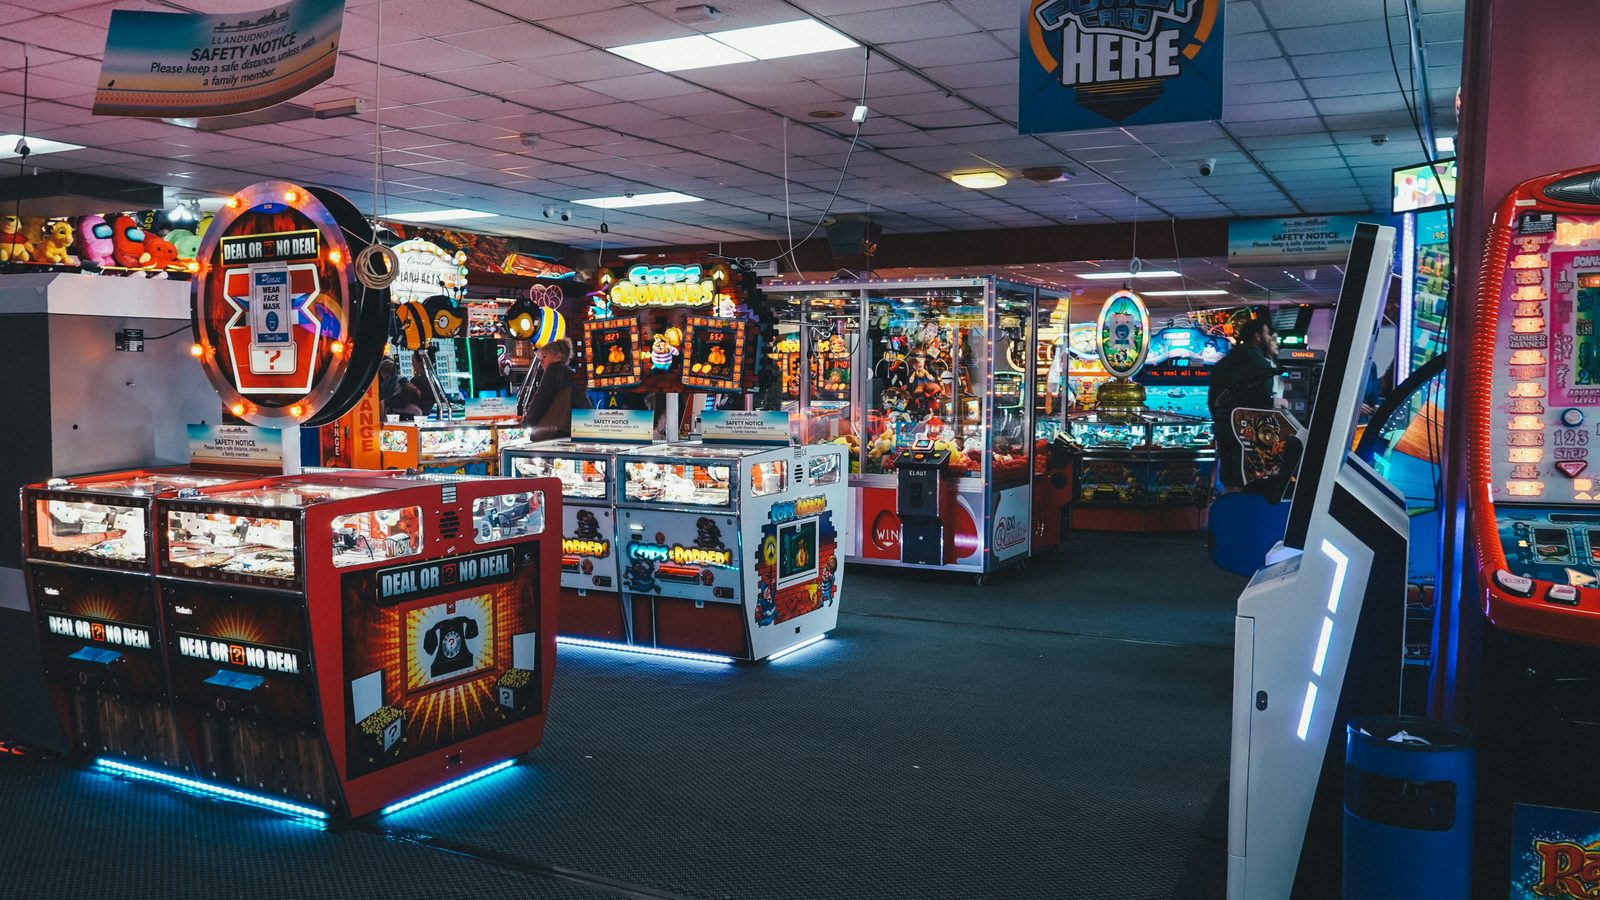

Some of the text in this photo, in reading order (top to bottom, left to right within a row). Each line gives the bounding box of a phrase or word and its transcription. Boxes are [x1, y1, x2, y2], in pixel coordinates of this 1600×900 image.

[1079, 8, 1152, 32] CARD
[150, 62, 183, 74] Please
[186, 63, 210, 75] keep
[220, 60, 239, 72] safe
[241, 55, 277, 70] distance,
[278, 47, 300, 62] unless
[301, 35, 316, 52] with
[190, 31, 298, 62] SAFETY NOTICE
[1062, 20, 1180, 85] HERE
[211, 75, 239, 88] family
[240, 68, 276, 83] member.
[1272, 231, 1340, 241] SAFETY NOTICE
[224, 243, 247, 261] DEAL
[249, 242, 263, 258] OR
[276, 239, 292, 256] NO
[292, 237, 317, 254] DEAL
[261, 273, 281, 284] Please
[629, 266, 700, 285] COPS
[1553, 429, 1589, 446] 123
[1554, 447, 1588, 459] STEP
[876, 529, 900, 541] WIN
[629, 543, 668, 561] COPS
[382, 570, 417, 598] DEAL
[420, 567, 439, 590] OR
[459, 558, 477, 582] NO
[480, 553, 510, 578] DEAL
[48, 615, 74, 637] DEAL
[75, 619, 91, 639] OR
[105, 625, 122, 646] NO
[123, 628, 150, 649] DEAL
[179, 636, 209, 660] DEAL
[211, 642, 228, 663] OR
[246, 647, 265, 669] NO
[267, 651, 300, 674] DEAL
